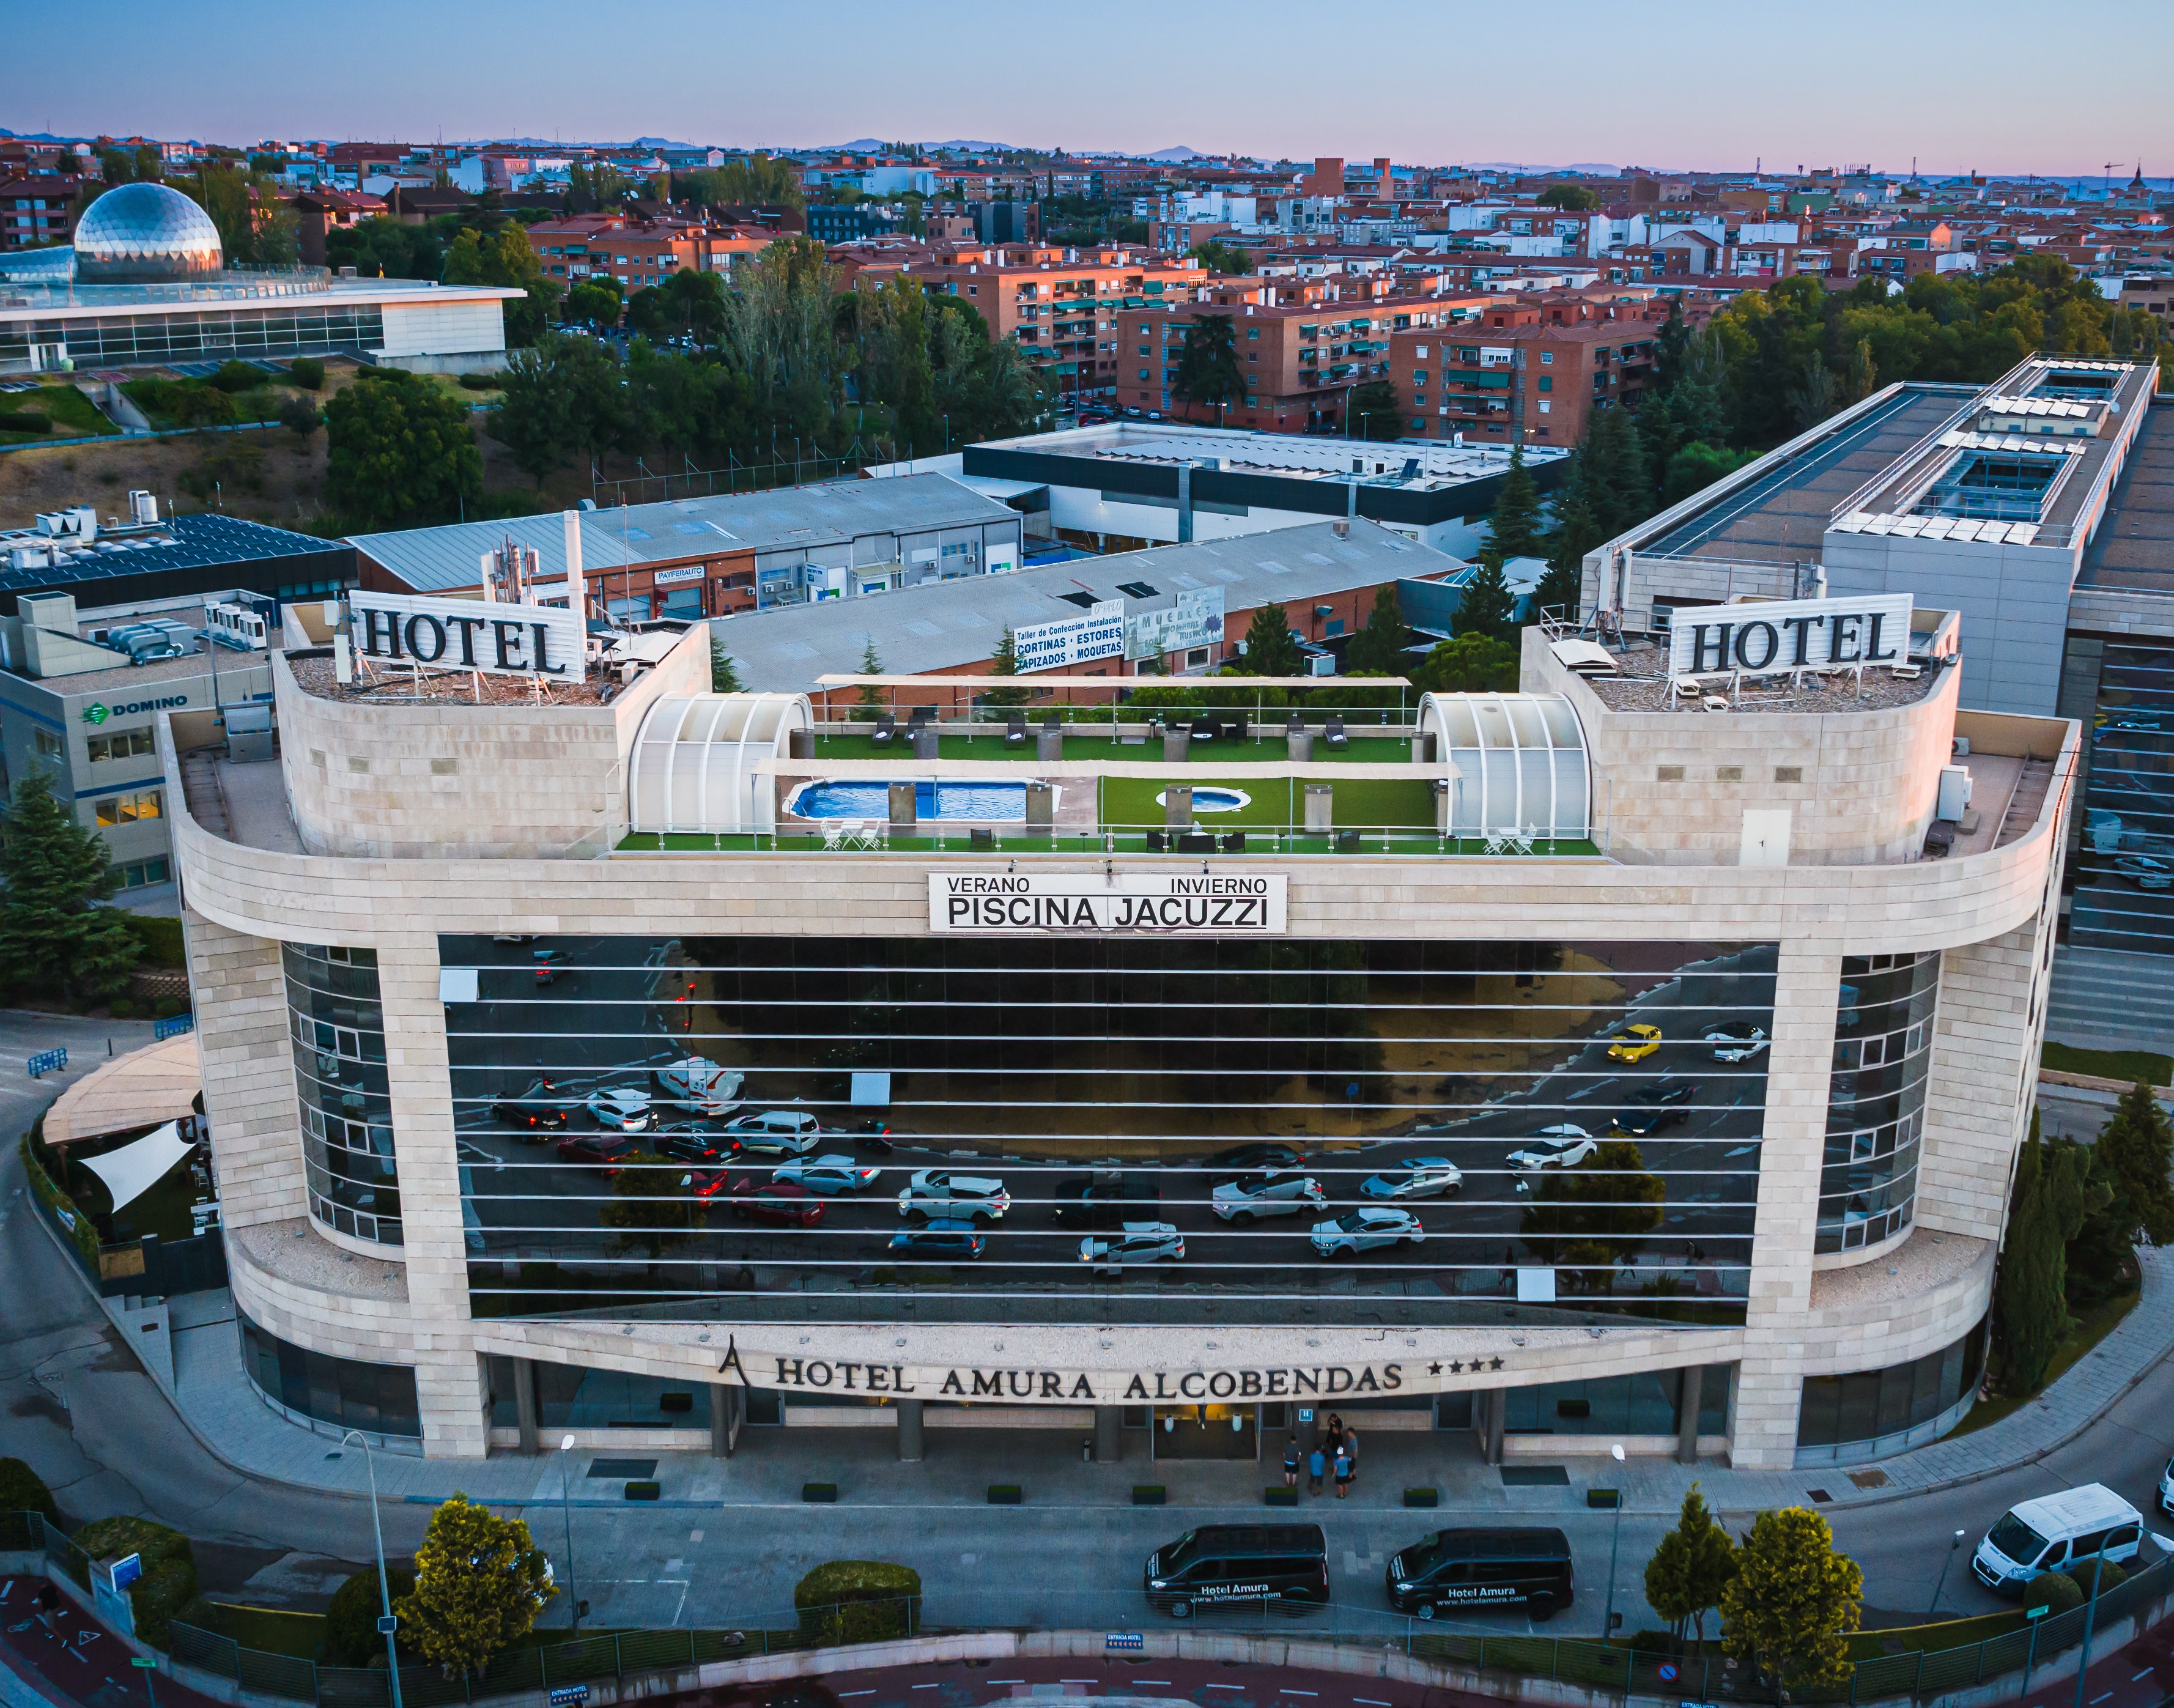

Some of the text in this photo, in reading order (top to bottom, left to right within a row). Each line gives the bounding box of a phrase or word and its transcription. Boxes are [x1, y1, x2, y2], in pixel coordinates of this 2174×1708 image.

[659, 567, 702, 579] PAYFERAUTO
[1018, 630, 1035, 641] Taller
[1049, 622, 1084, 635] Confección
[1088, 615, 1122, 628] Instalación
[361, 608, 566, 674] HOTEL
[1018, 627, 1122, 655] CORTINAS ESTORES
[1690, 613, 1897, 673] HOTEL
[113, 695, 188, 716] DOMINO
[947, 878, 1267, 893] VERANO INVIERNO
[948, 897, 1267, 926] PISCINA JACUZZI
[775, 1357, 1402, 1399] HOTEL AMURA ALCOBENDAS
[1190, 1591, 1281, 1603] www.hotelamura.com
[1202, 1584, 1268, 1595] Hotel Amura
[1449, 1588, 1515, 1598] Hotel Amura
[1436, 1595, 1527, 1606] www.hotelamura.com
[552, 1688, 572, 1697] ENTRADA
